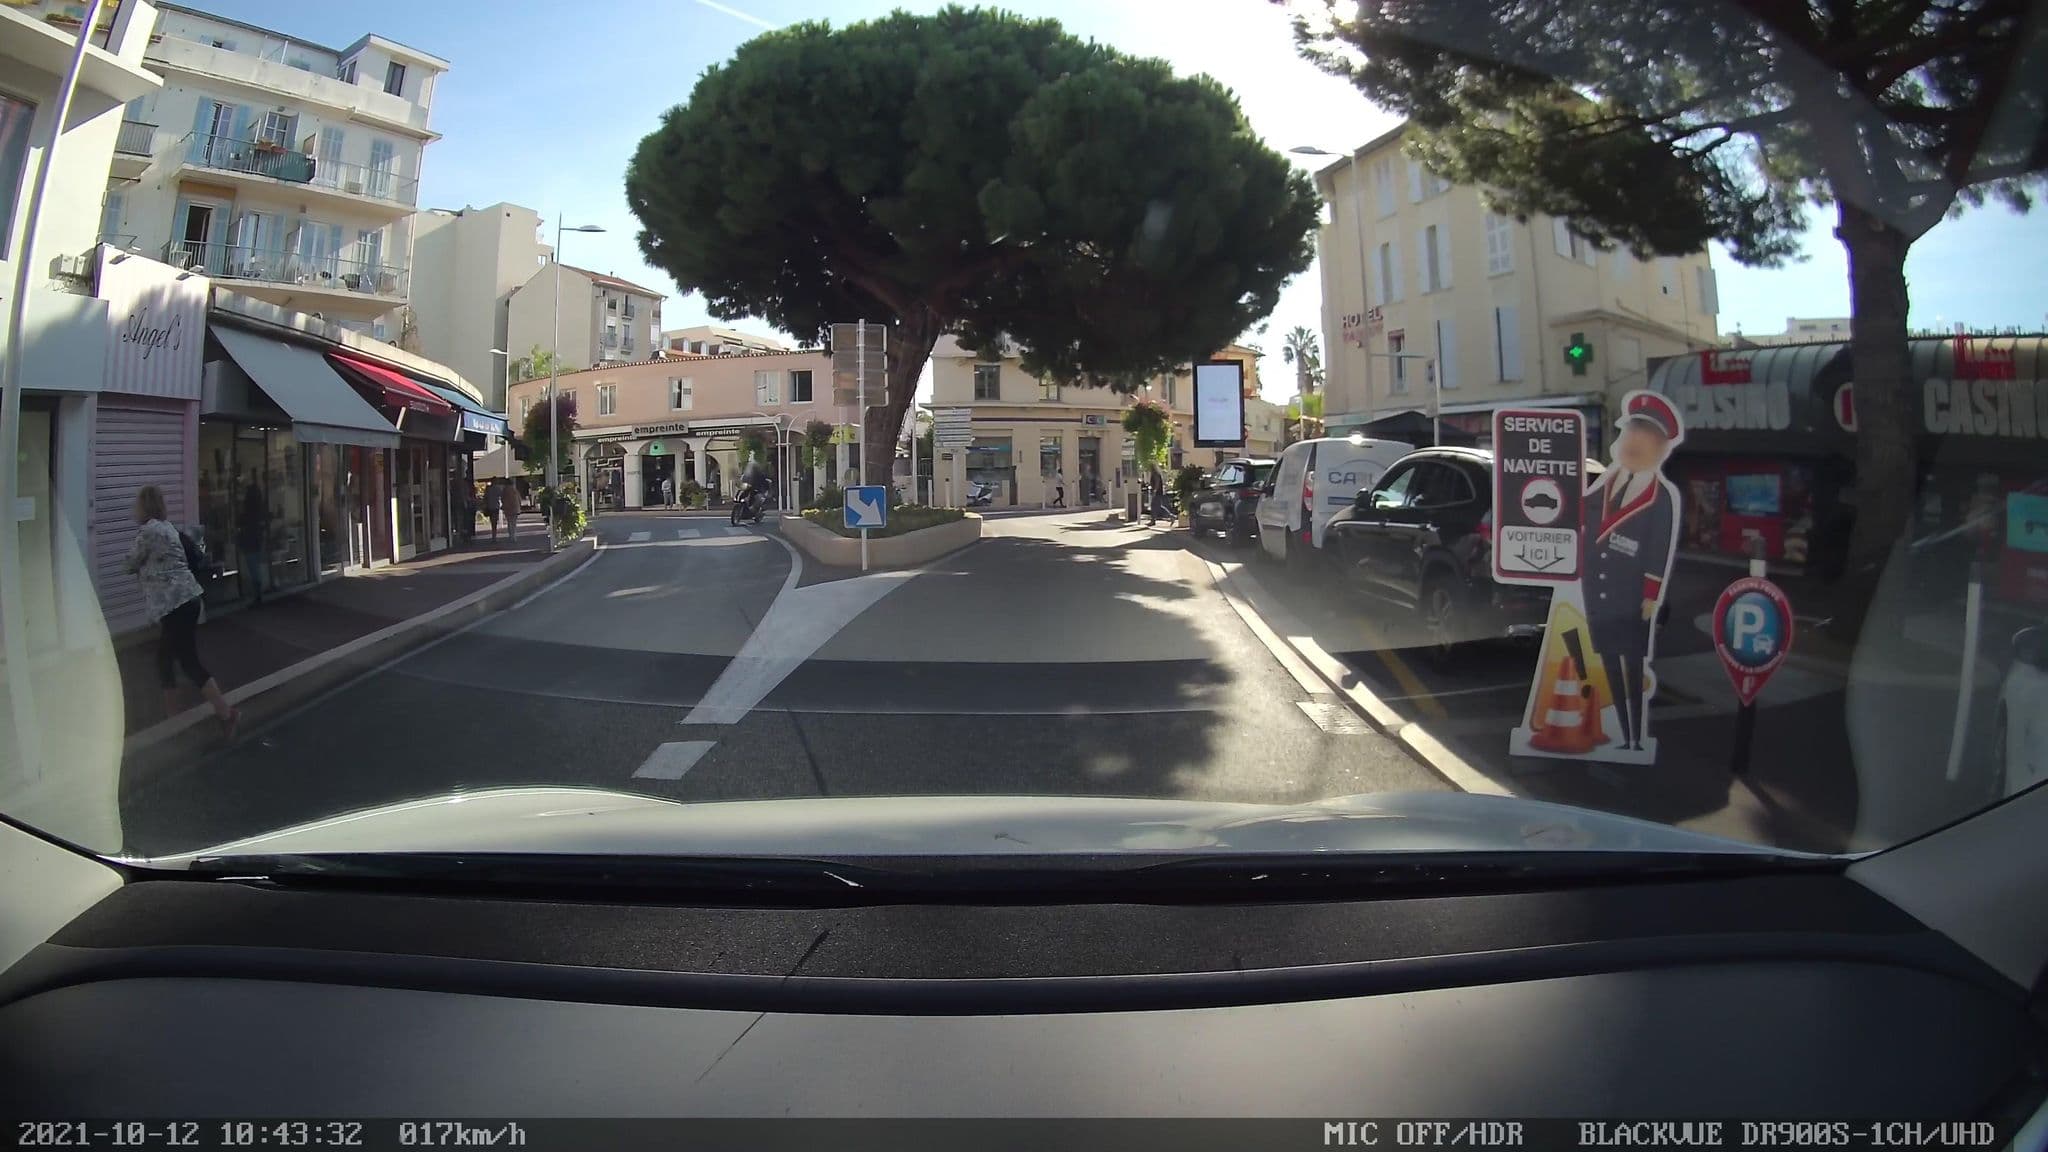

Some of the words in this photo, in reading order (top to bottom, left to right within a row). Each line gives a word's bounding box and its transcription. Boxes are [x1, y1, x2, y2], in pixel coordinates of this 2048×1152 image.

[1342, 306, 1384, 329] HOEL
[122, 306, 182, 360] Angel's
[1676, 382, 1791, 431] CASINO
[634, 422, 686, 435] empreinte
[695, 428, 741, 437] empreinte
[1504, 416, 1575, 434] SERVICE
[1528, 438, 1552, 454] DE
[1503, 458, 1578, 477] NAVETTE
[1507, 531, 1573, 544] VOITURIER
[1530, 548, 1549, 561] ICI
[1733, 602, 1765, 650] P
